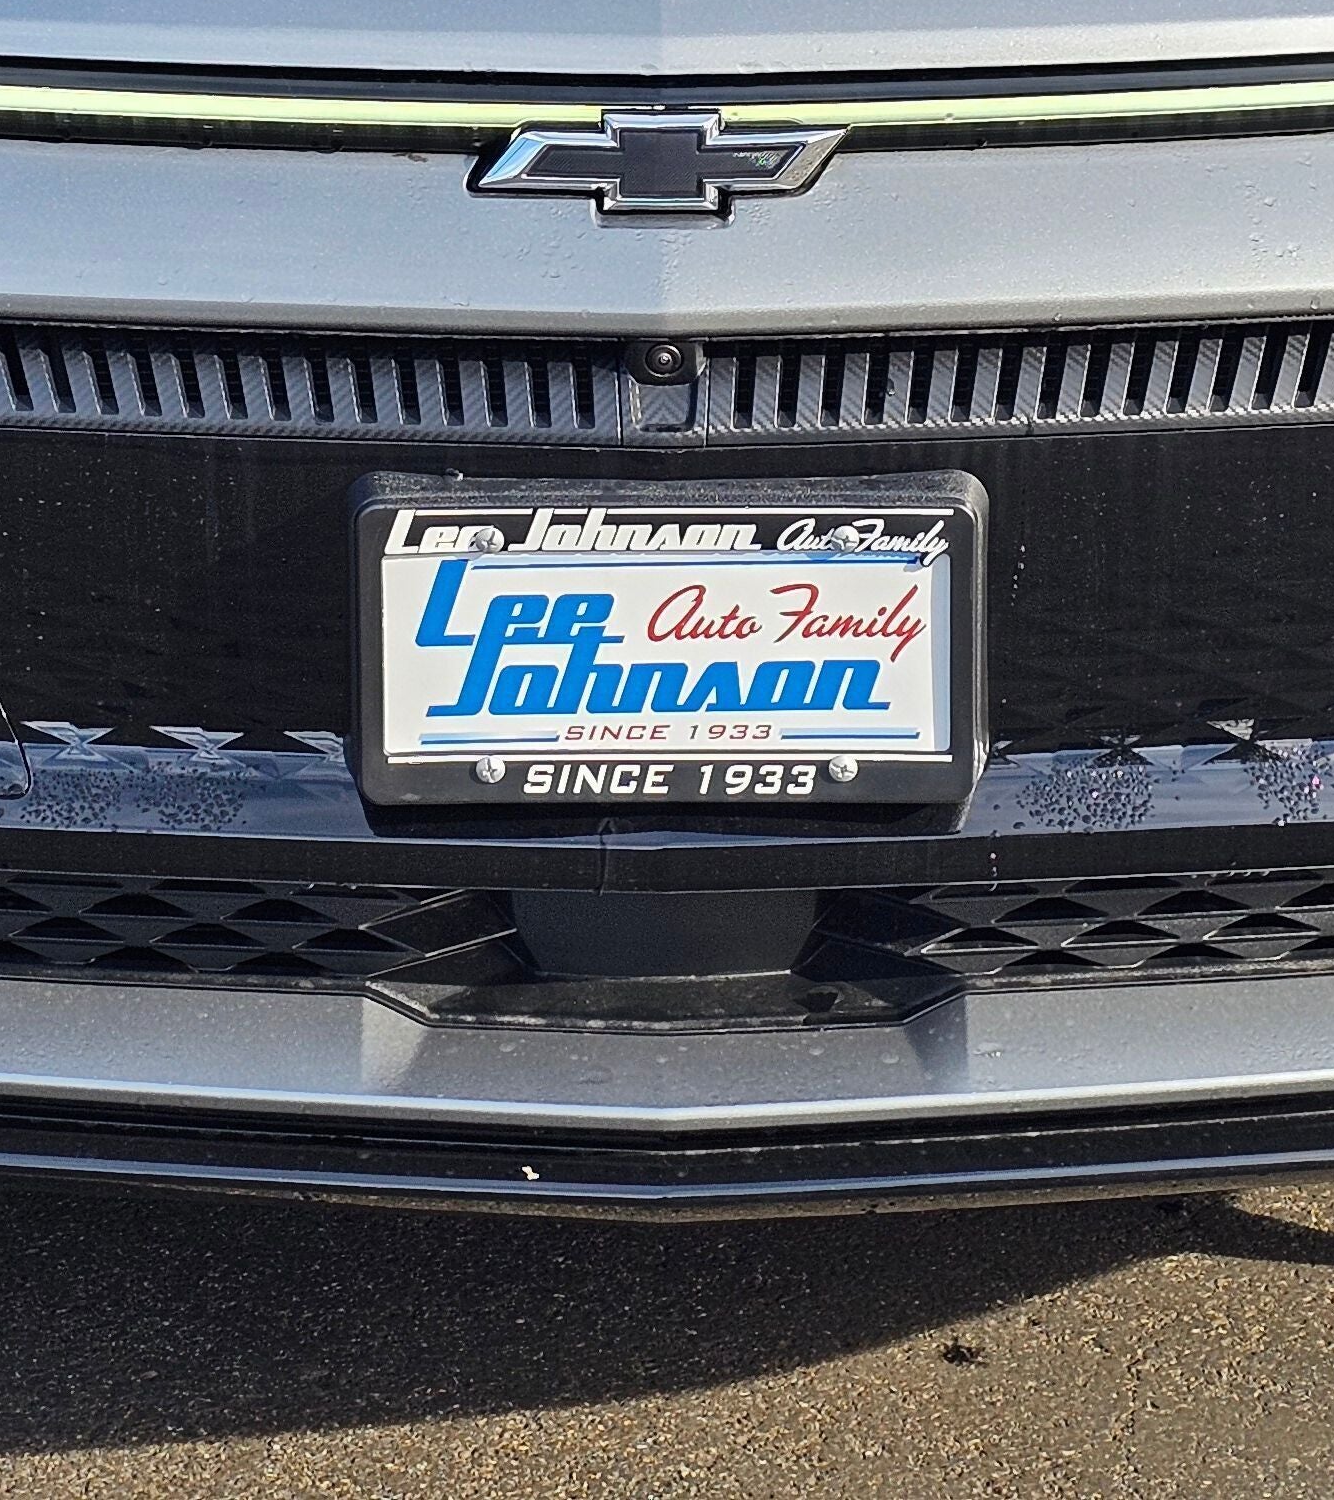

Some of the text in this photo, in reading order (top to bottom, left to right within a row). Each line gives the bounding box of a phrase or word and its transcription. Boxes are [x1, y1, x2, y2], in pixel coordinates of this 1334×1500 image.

[507, 507, 762, 553] Johnson
[776, 518, 854, 553] Aut
[851, 518, 950, 566] Family
[415, 559, 926, 662] Lee Auto Family
[426, 634, 890, 718] Johnson
[564, 724, 773, 741] SINCE 1933
[522, 763, 817, 796] SINCE 1933
